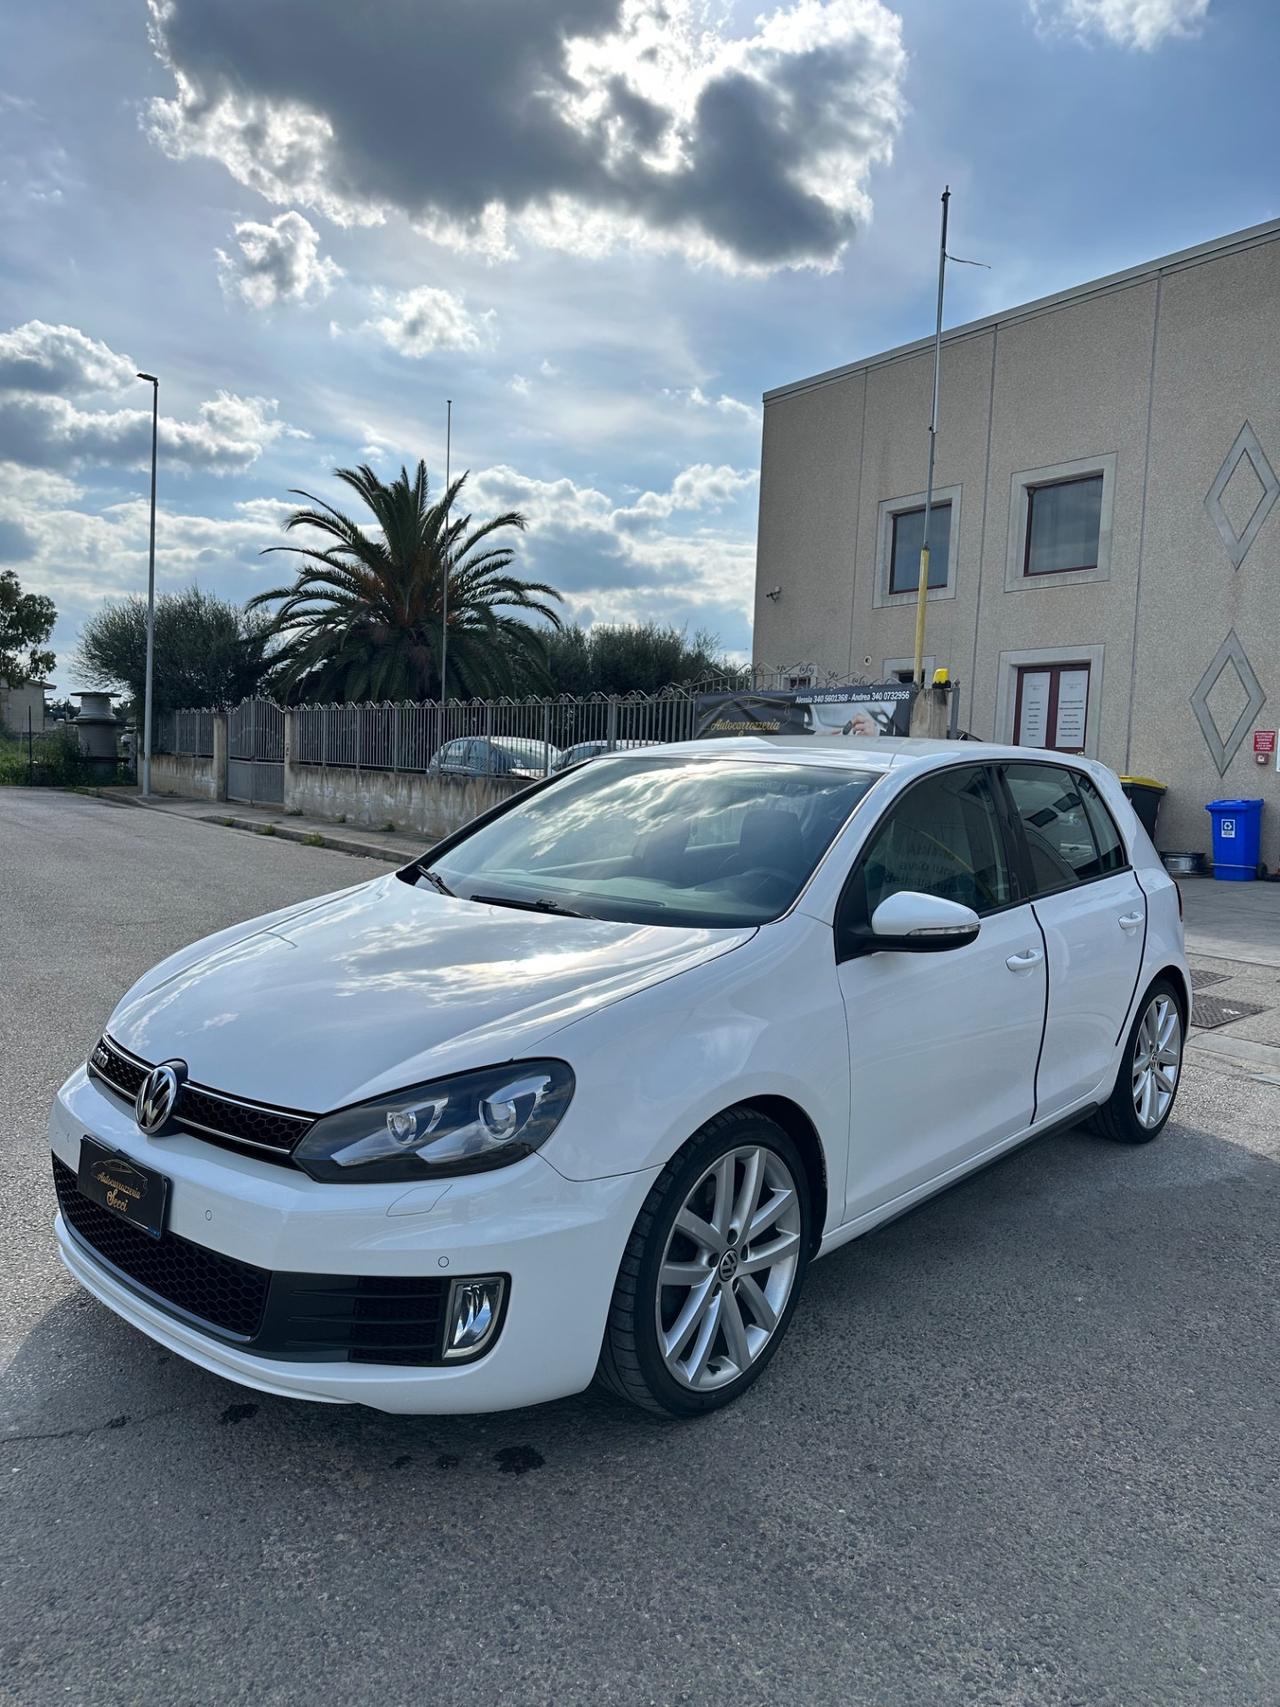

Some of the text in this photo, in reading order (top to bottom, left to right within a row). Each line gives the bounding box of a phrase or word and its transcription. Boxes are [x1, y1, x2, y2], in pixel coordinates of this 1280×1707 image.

[813, 695, 824, 703] 340
[851, 693, 871, 702] Andrea
[871, 692, 883, 701] 340
[711, 719, 780, 731] Autocarrozzeria
[106, 1188, 128, 1212] Secci
